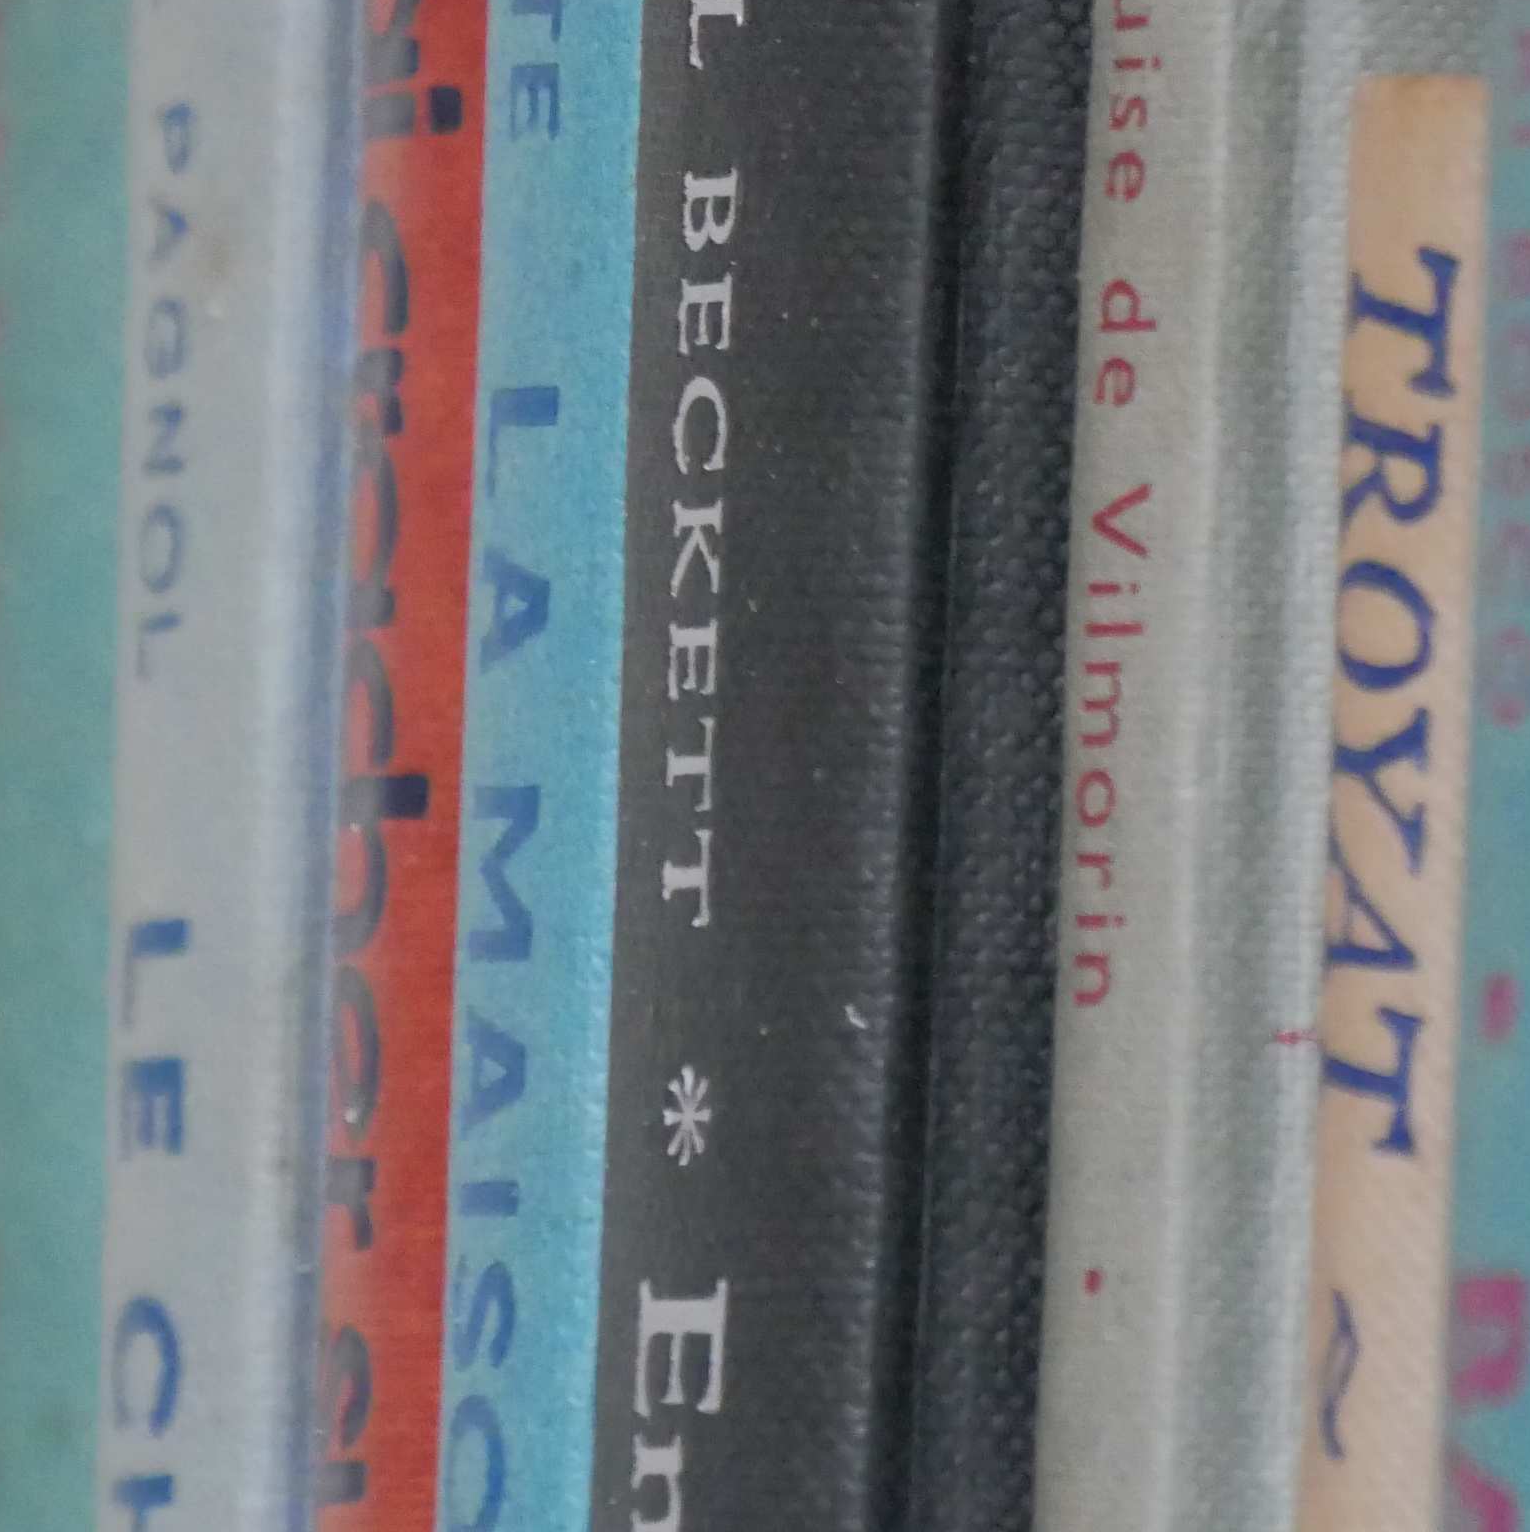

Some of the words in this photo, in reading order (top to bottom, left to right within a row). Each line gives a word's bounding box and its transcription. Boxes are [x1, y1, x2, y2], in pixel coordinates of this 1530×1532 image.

[135, 101, 197, 682] PAGNOL
[480, 384, 561, 668] LA
[659, 169, 739, 928] BECKETT
[1093, 278, 1158, 408] de
[1070, 483, 1153, 1008] Vilmorin
[1320, 244, 1464, 1158] TROYAT
[119, 916, 190, 1164] LE
